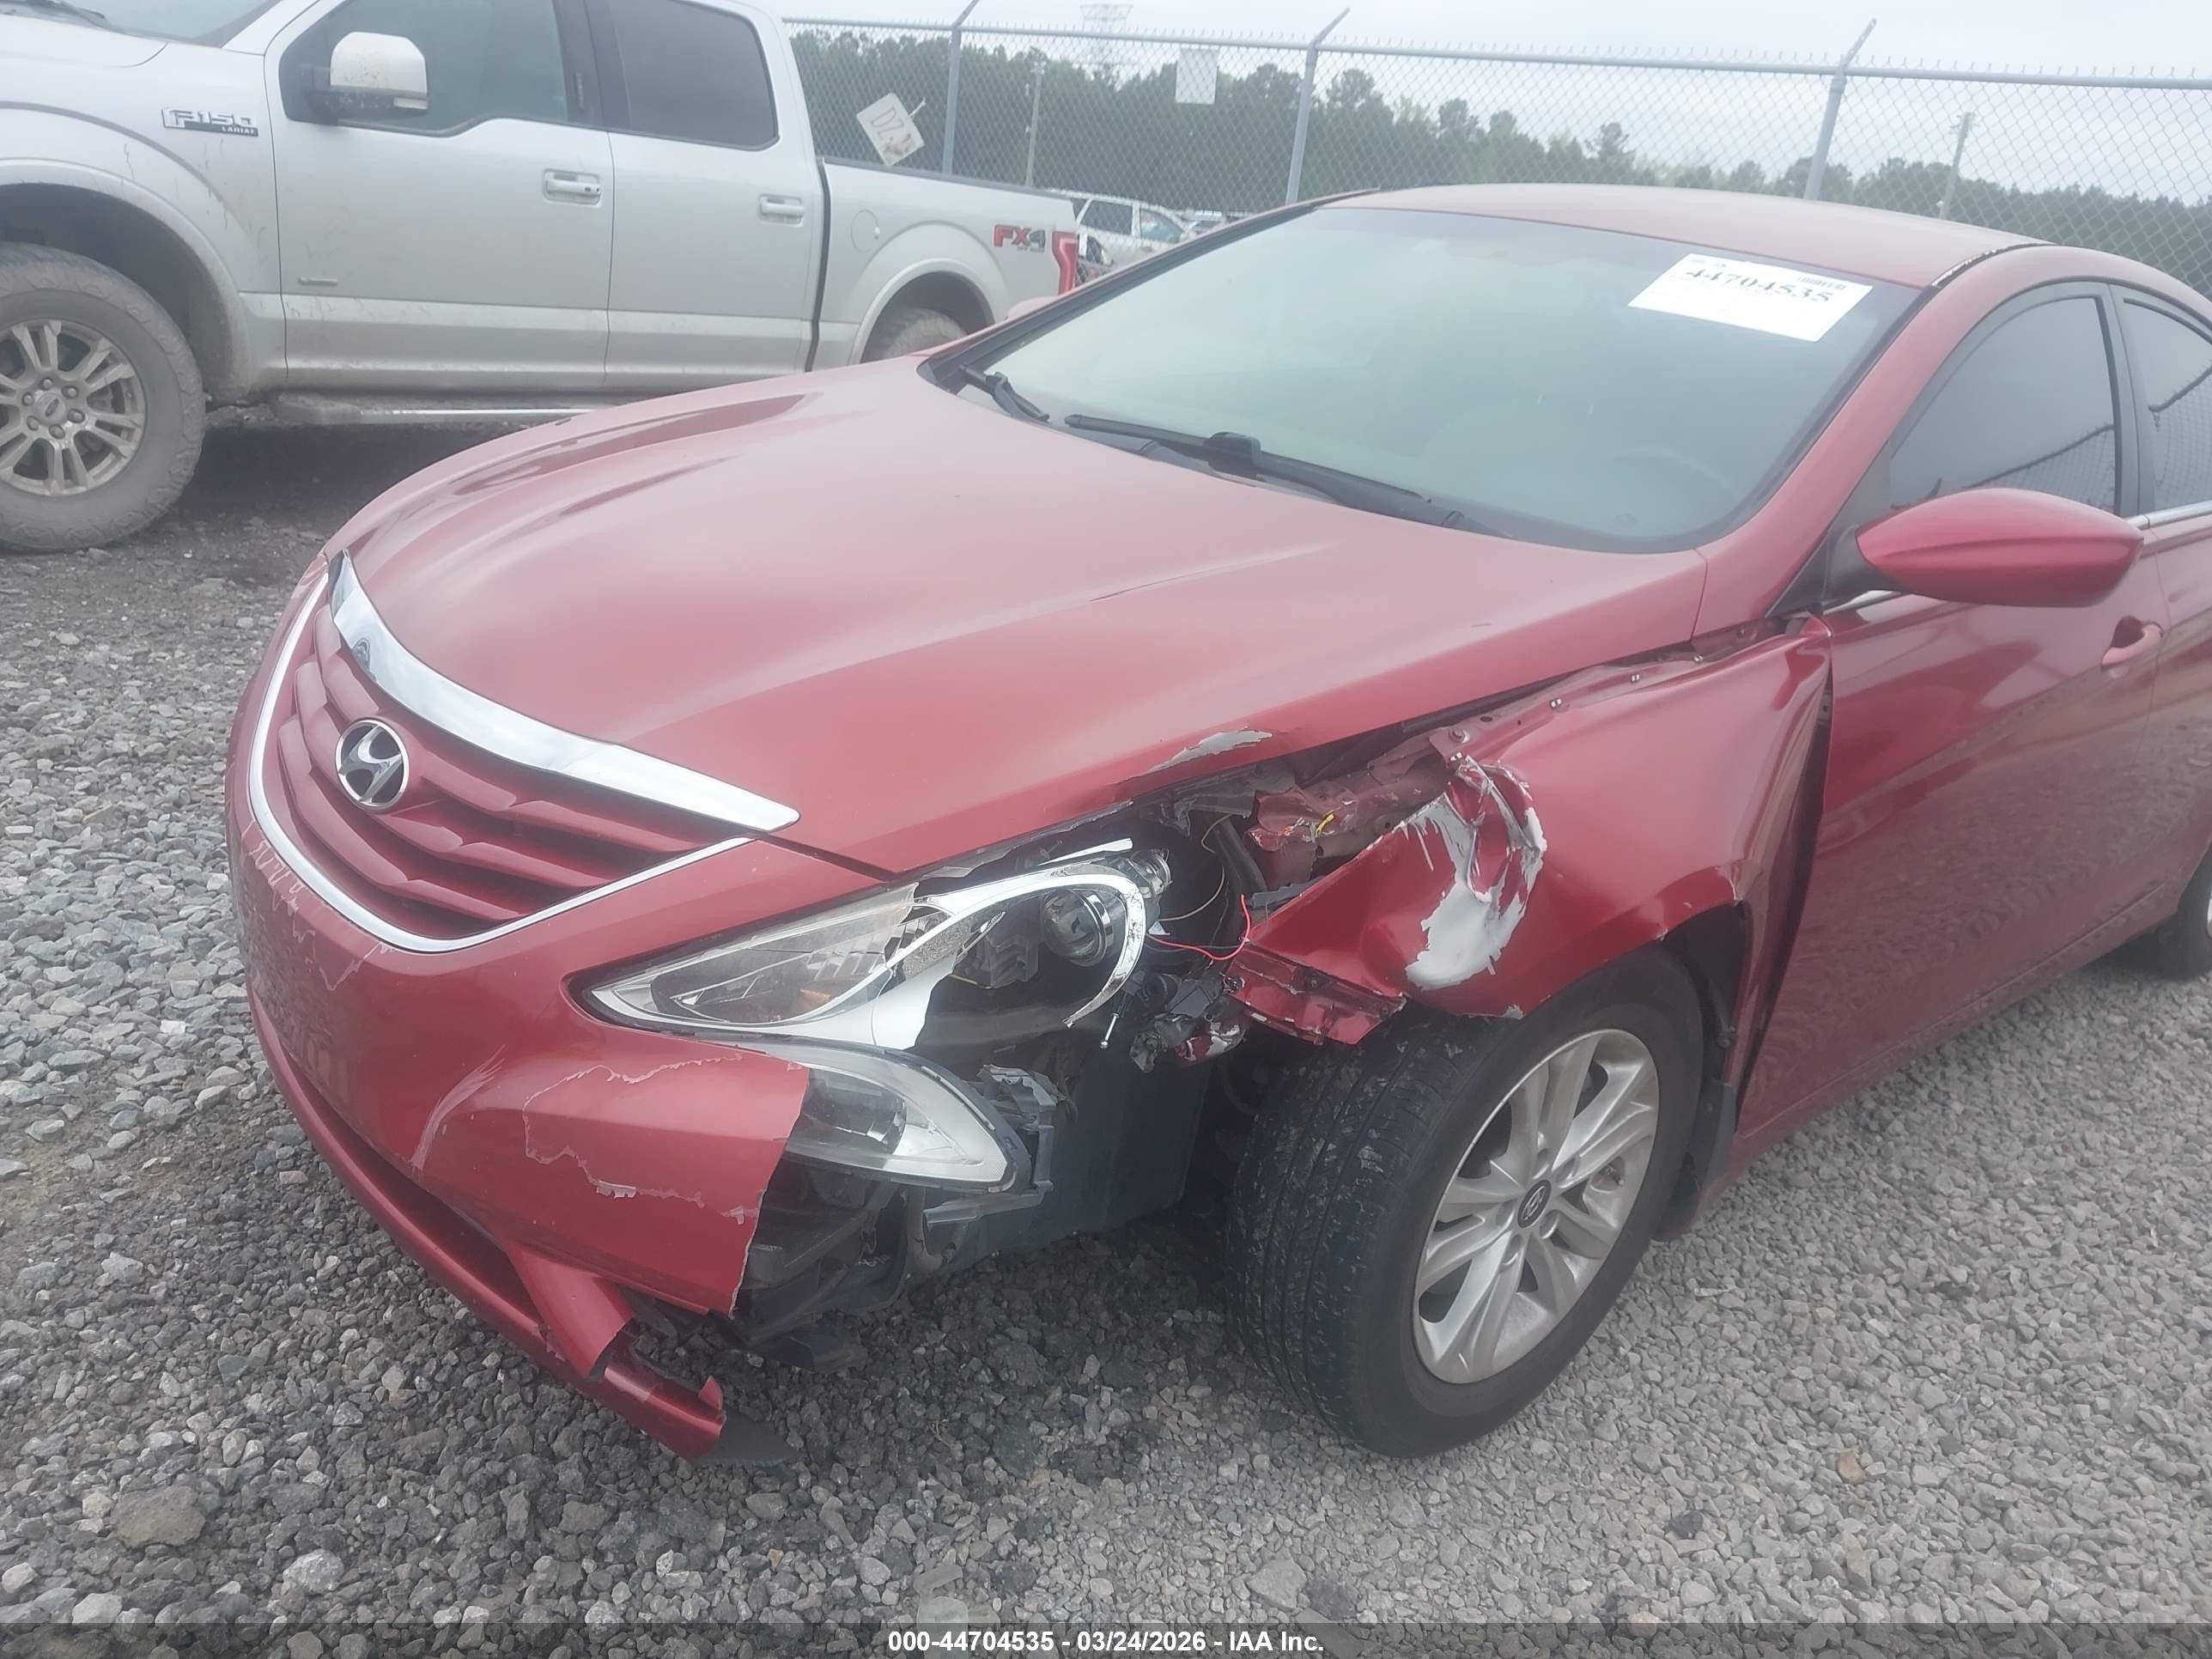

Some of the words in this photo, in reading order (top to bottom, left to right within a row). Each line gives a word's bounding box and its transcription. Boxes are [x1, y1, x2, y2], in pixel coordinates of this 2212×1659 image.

[222, 125, 256, 136] LARIAT
[994, 224, 1045, 247] FX4
[1686, 268, 1834, 302] 44704535
